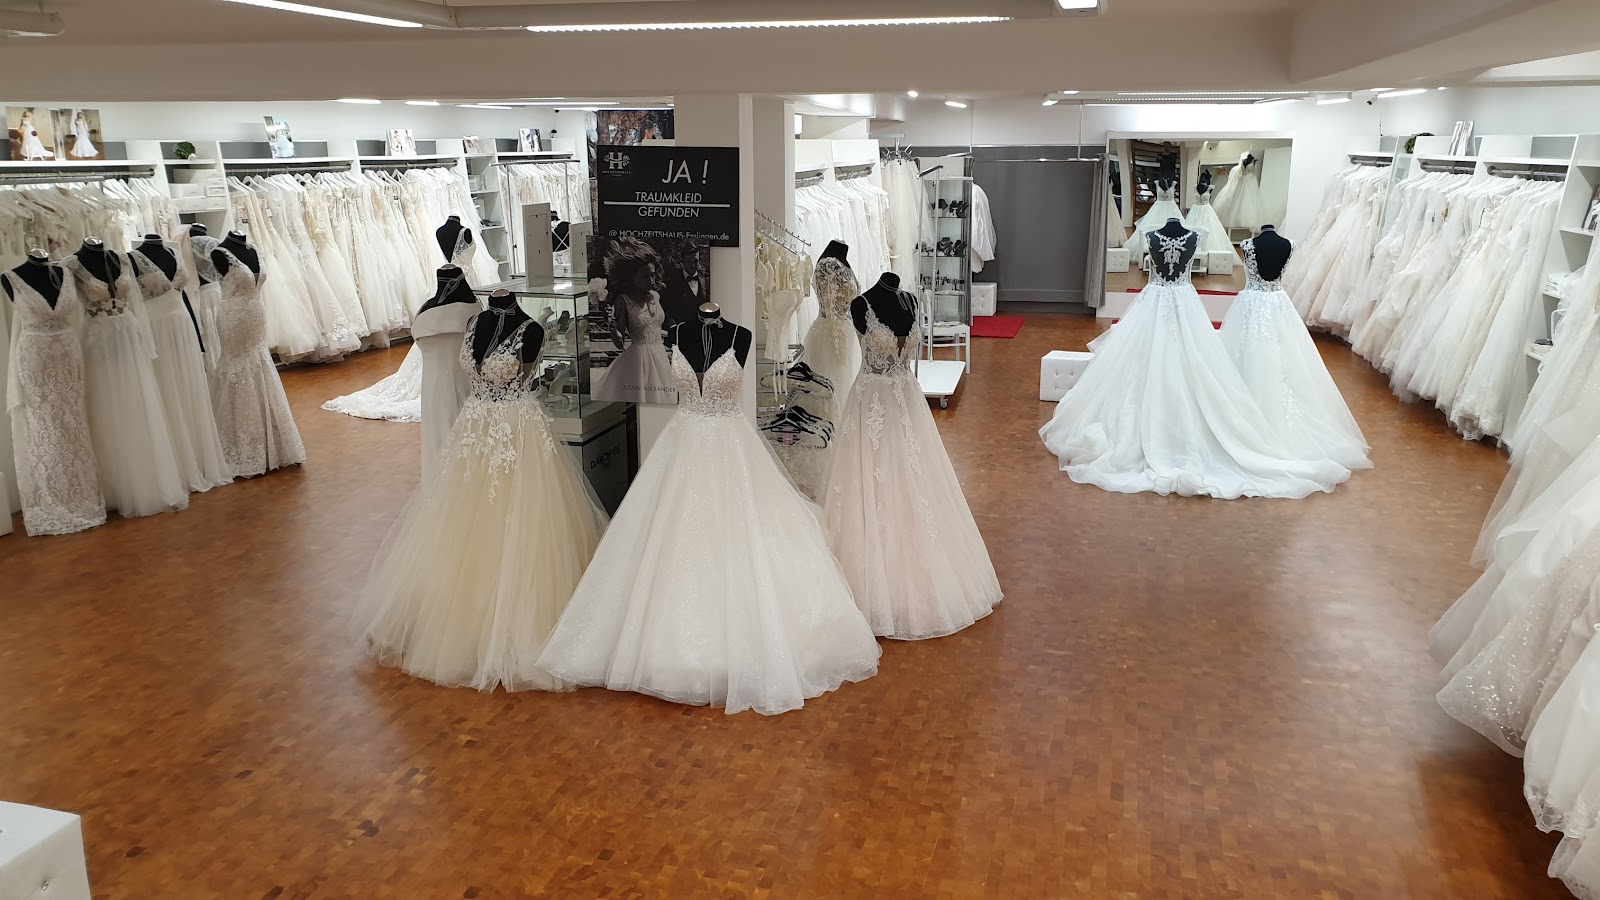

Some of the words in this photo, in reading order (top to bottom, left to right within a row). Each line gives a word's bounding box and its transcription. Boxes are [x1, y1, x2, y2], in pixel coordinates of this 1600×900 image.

[661, 159, 692, 184] JA
[701, 159, 709, 185] !
[635, 191, 702, 203] TRAUMKLEID
[638, 206, 700, 218] GEFUNDEN
[608, 229, 618, 238] @
[623, 384, 641, 392] JUSTIN
[643, 385, 677, 393] ALEXANDER
